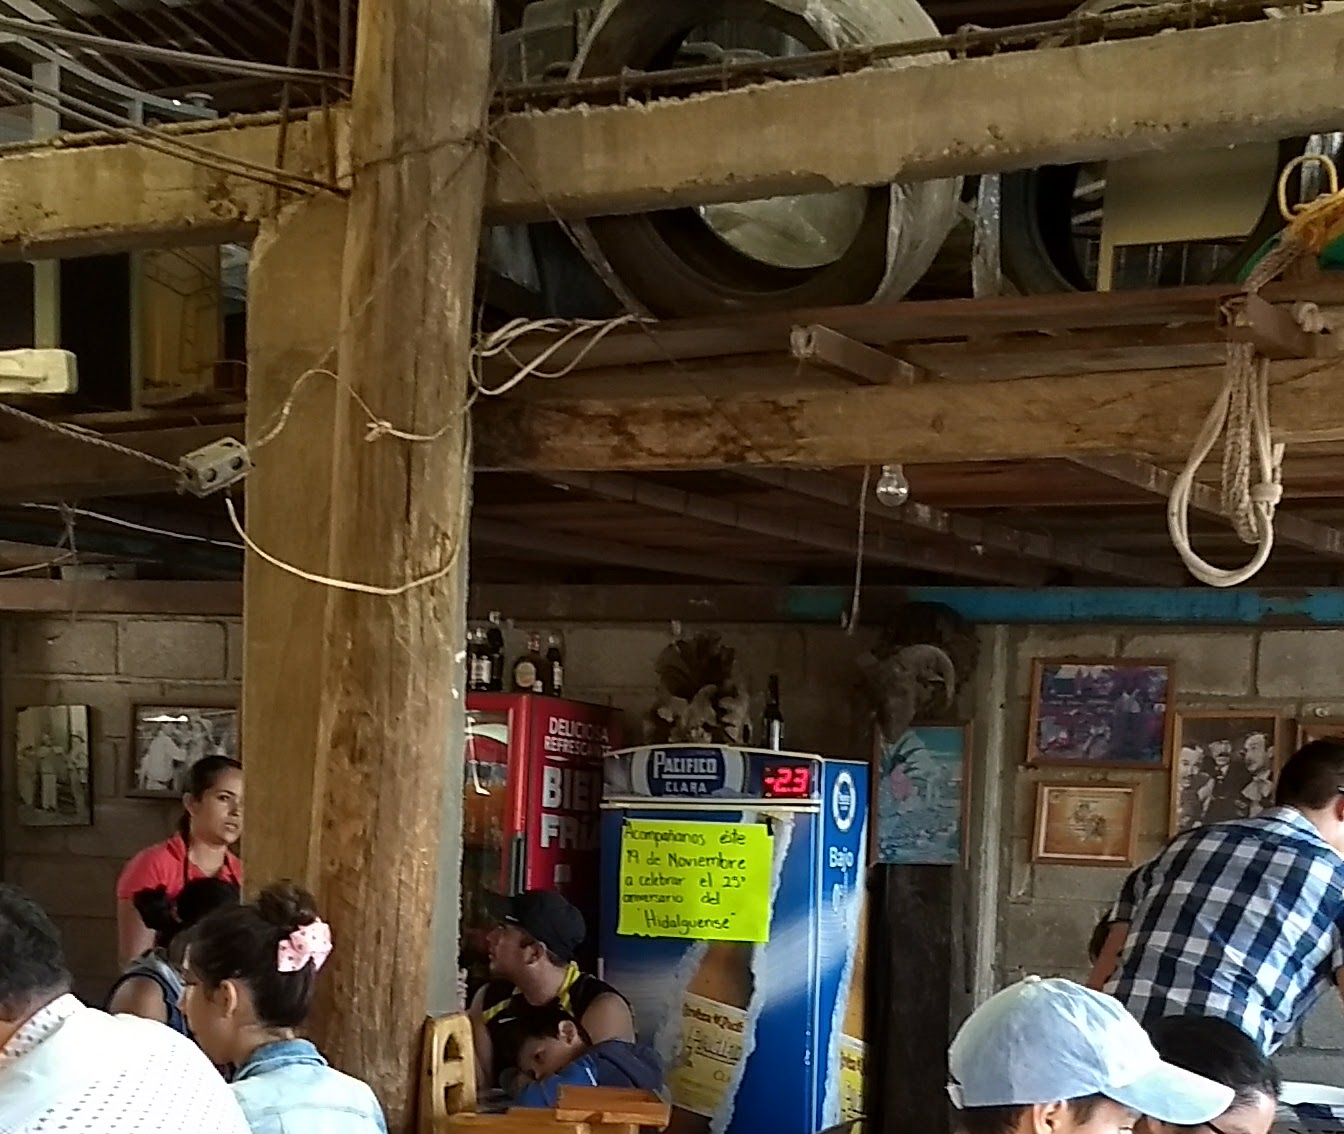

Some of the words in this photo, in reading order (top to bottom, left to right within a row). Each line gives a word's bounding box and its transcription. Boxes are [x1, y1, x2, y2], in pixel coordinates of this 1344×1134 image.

[654, 751, 718, 779] PACIFICO
[665, 781, 707, 794] CLARA
[646, 851, 661, 866] de
[668, 852, 746, 869] Noviembre
[829, 846, 854, 872] Bajo
[625, 876, 633, 886] a
[639, 872, 685, 886] celebrar
[699, 872, 713, 887] el
[700, 891, 720, 905] del
